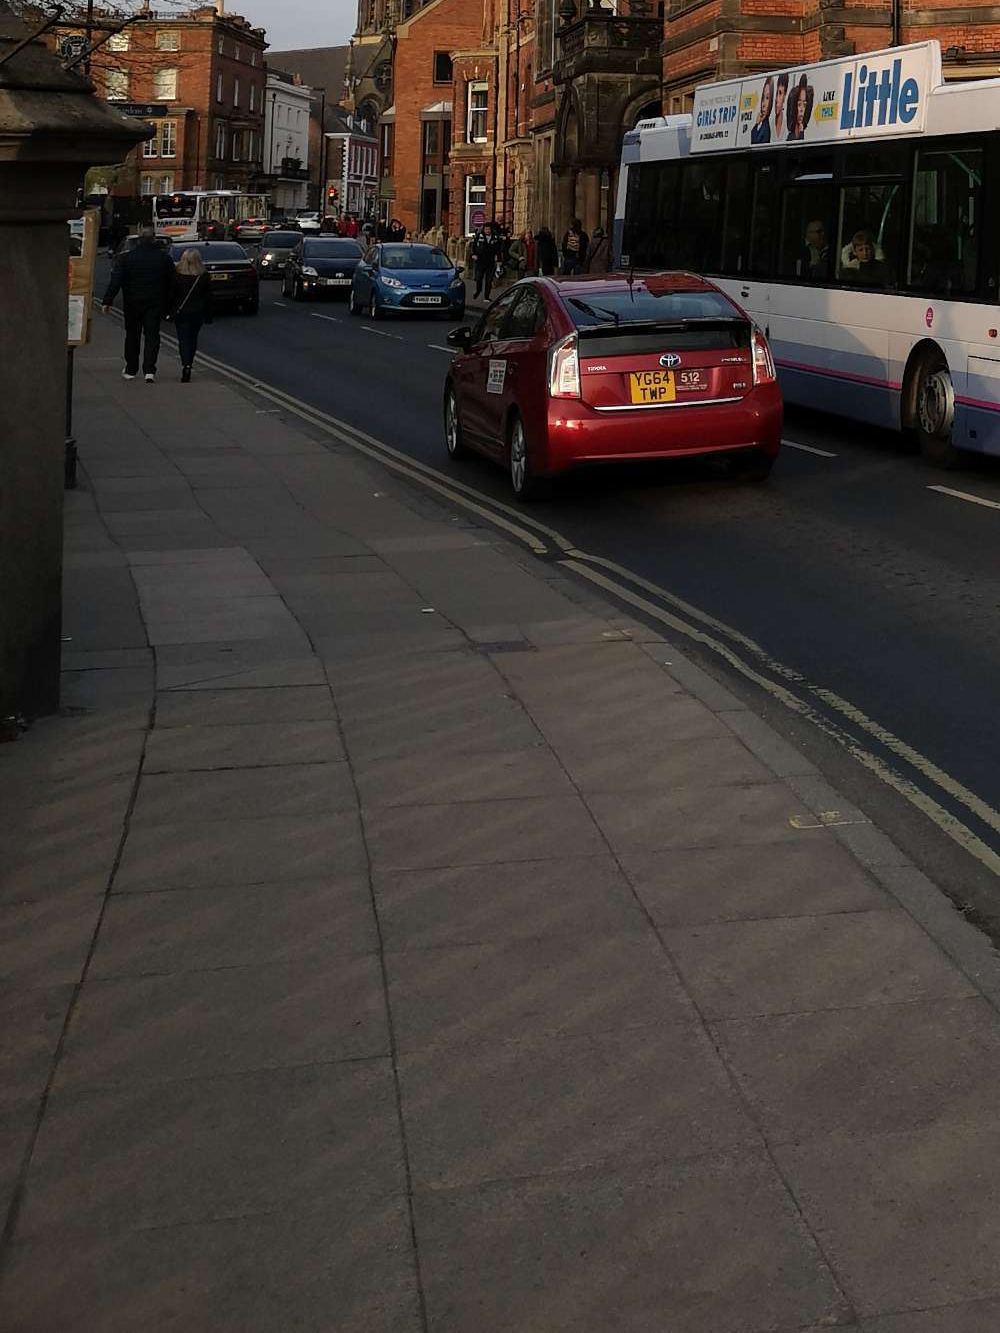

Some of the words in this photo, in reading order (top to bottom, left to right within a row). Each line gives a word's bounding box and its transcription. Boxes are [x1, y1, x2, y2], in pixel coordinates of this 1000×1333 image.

[823, 90, 836, 102] LIKE
[840, 58, 919, 130] Little
[697, 108, 717, 127] GIRLS
[718, 105, 737, 124] TRIP
[634, 370, 671, 386] YG64
[680, 371, 700, 382] 512
[640, 387, 667, 400] TWP
